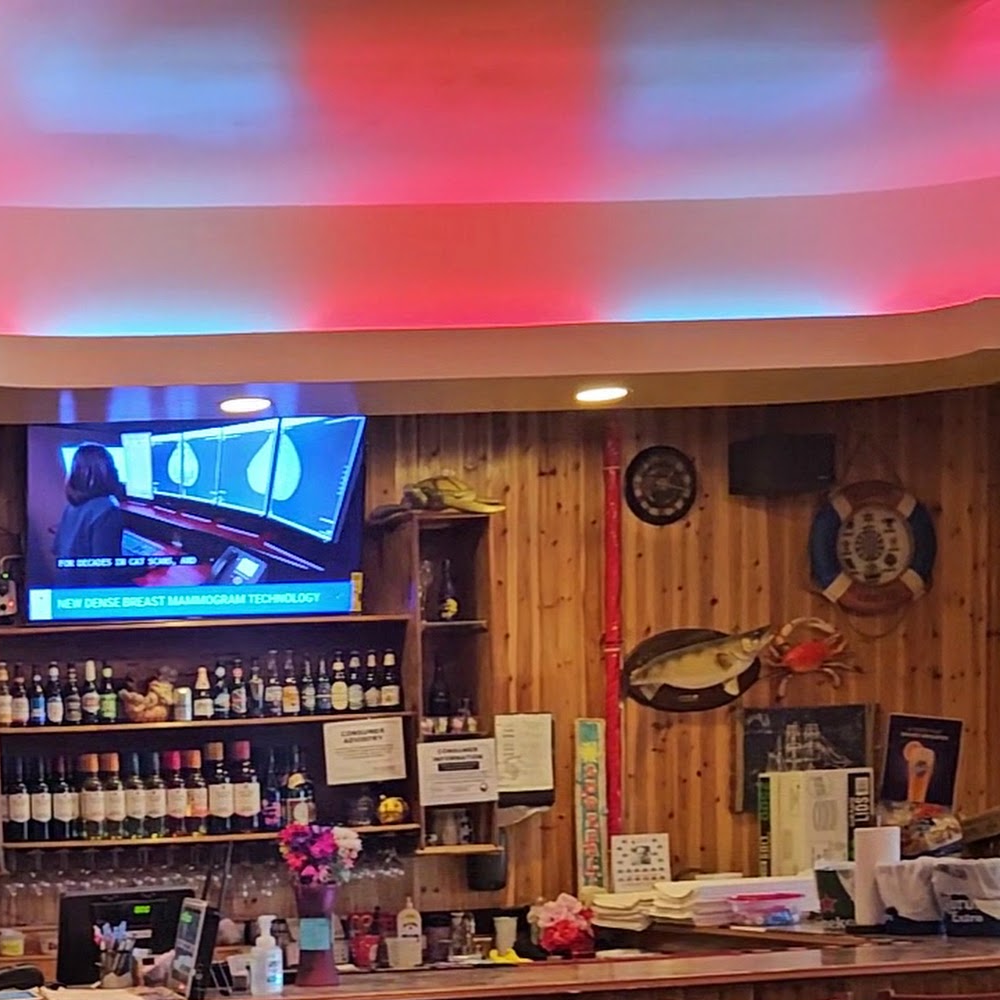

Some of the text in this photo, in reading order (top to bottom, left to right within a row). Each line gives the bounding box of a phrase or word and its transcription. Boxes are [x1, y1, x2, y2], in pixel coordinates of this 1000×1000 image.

[57, 592, 321, 609] NEW DENSE BREAST MAMMOGRAM TECHNOLOGY
